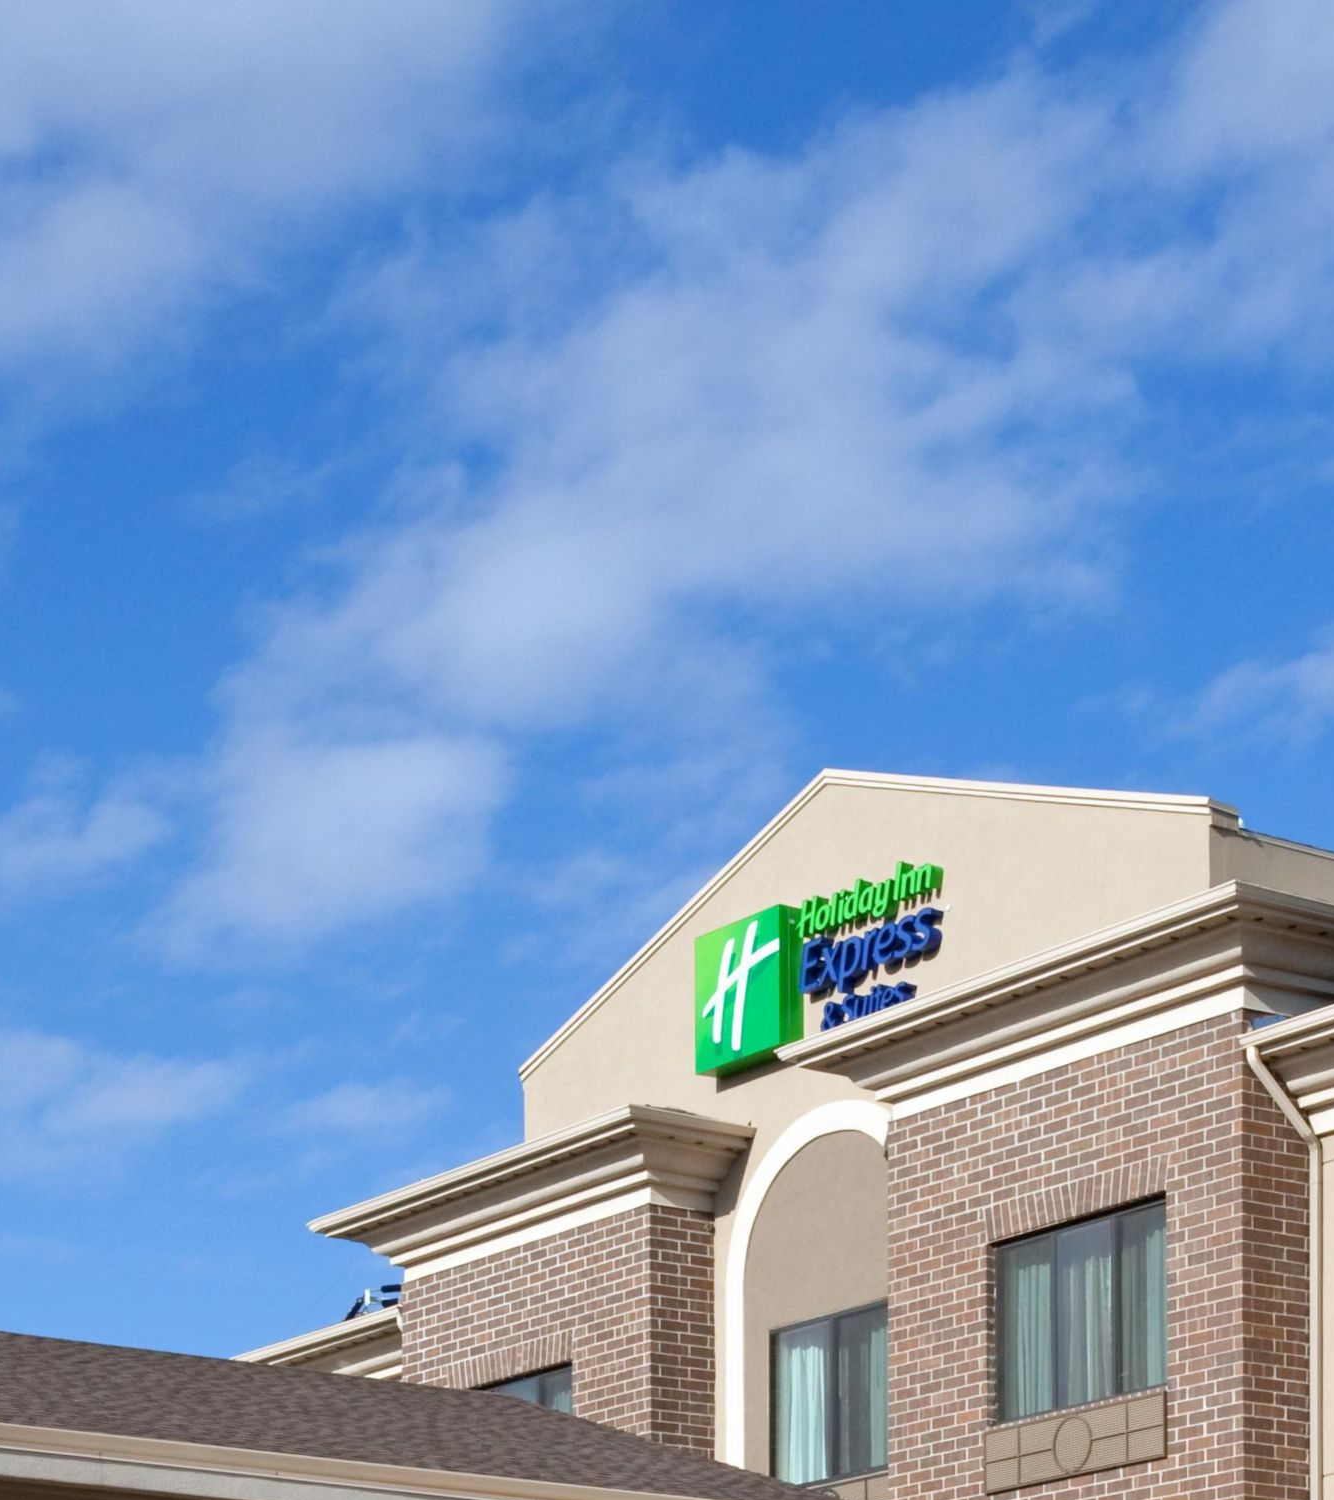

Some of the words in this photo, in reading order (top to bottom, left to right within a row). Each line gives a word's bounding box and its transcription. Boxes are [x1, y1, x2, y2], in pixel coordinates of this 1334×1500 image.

[797, 879, 892, 938] Holiday
[893, 861, 941, 901] Inn
[799, 907, 943, 993] Express
